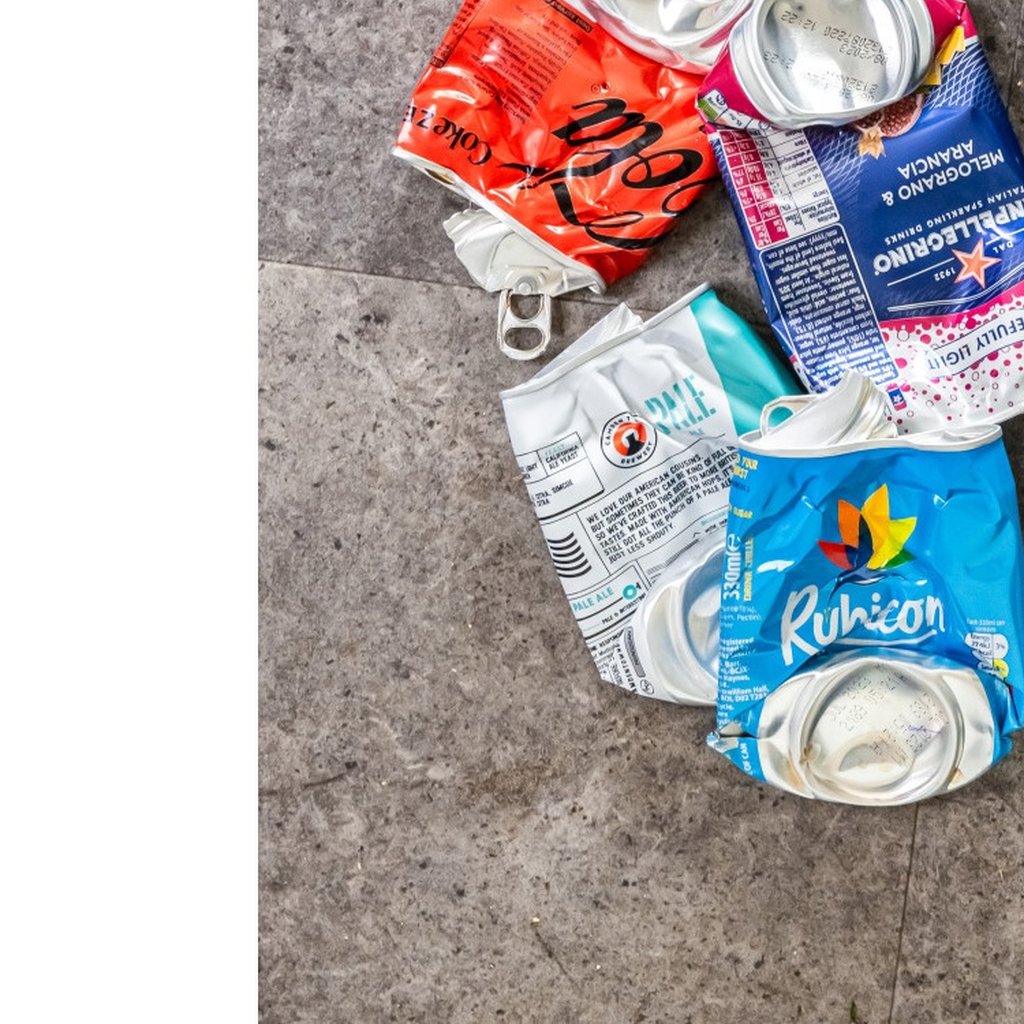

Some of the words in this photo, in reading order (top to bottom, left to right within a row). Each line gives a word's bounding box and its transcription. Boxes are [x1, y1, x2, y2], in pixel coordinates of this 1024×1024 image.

[402, 105, 435, 130] ZE
[432, 117, 492, 165] Coke
[897, 139, 973, 179] ARANCIA
[896, 148, 1004, 201] MELOGRANO
[881, 190, 896, 207] &
[925, 200, 984, 228] SPARKLING
[883, 223, 923, 245] DRINKS
[991, 239, 1014, 255] DAL
[933, 266, 956, 282] 1932
[587, 513, 599, 524] WE
[600, 503, 618, 516] LOVE
[618, 492, 633, 504] OUR
[634, 472, 669, 495] AMERICAN
[670, 452, 703, 474] COUSINS.
[591, 521, 605, 532] BUT
[605, 497, 644, 523] SOMETIMES
[644, 488, 660, 500] THEY
[662, 479, 676, 490] CAN
[687, 463, 703, 476] KIND
[703, 457, 712, 466] OF
[711, 449, 726, 460] FULL
[596, 531, 606, 541] SO
[628, 501, 657, 521] CRAFTED
[658, 492, 672, 504] THIS
[672, 481, 688, 493] BEER
[689, 475, 699, 484] TO
[699, 465, 718, 479] MORE
[717, 451, 739, 468] BRITIS
[604, 543, 622, 557] STILL
[623, 535, 637, 546] GOT
[638, 527, 651, 538] ALL
[652, 519, 664, 530] THE
[664, 504, 687, 521] PUNCH
[685, 496, 695, 505] OF
[695, 492, 702, 500] A
[703, 485, 719, 497] PALE
[628, 517, 648, 532] MADE
[649, 507, 667, 521] WITH
[668, 483, 700, 509] AMERICAN
[609, 551, 626, 564] JUST
[627, 540, 646, 554] LESS
[573, 598, 593, 611] PALE
[597, 588, 613, 601] ALE
[740, 743, 748, 758] CAN
